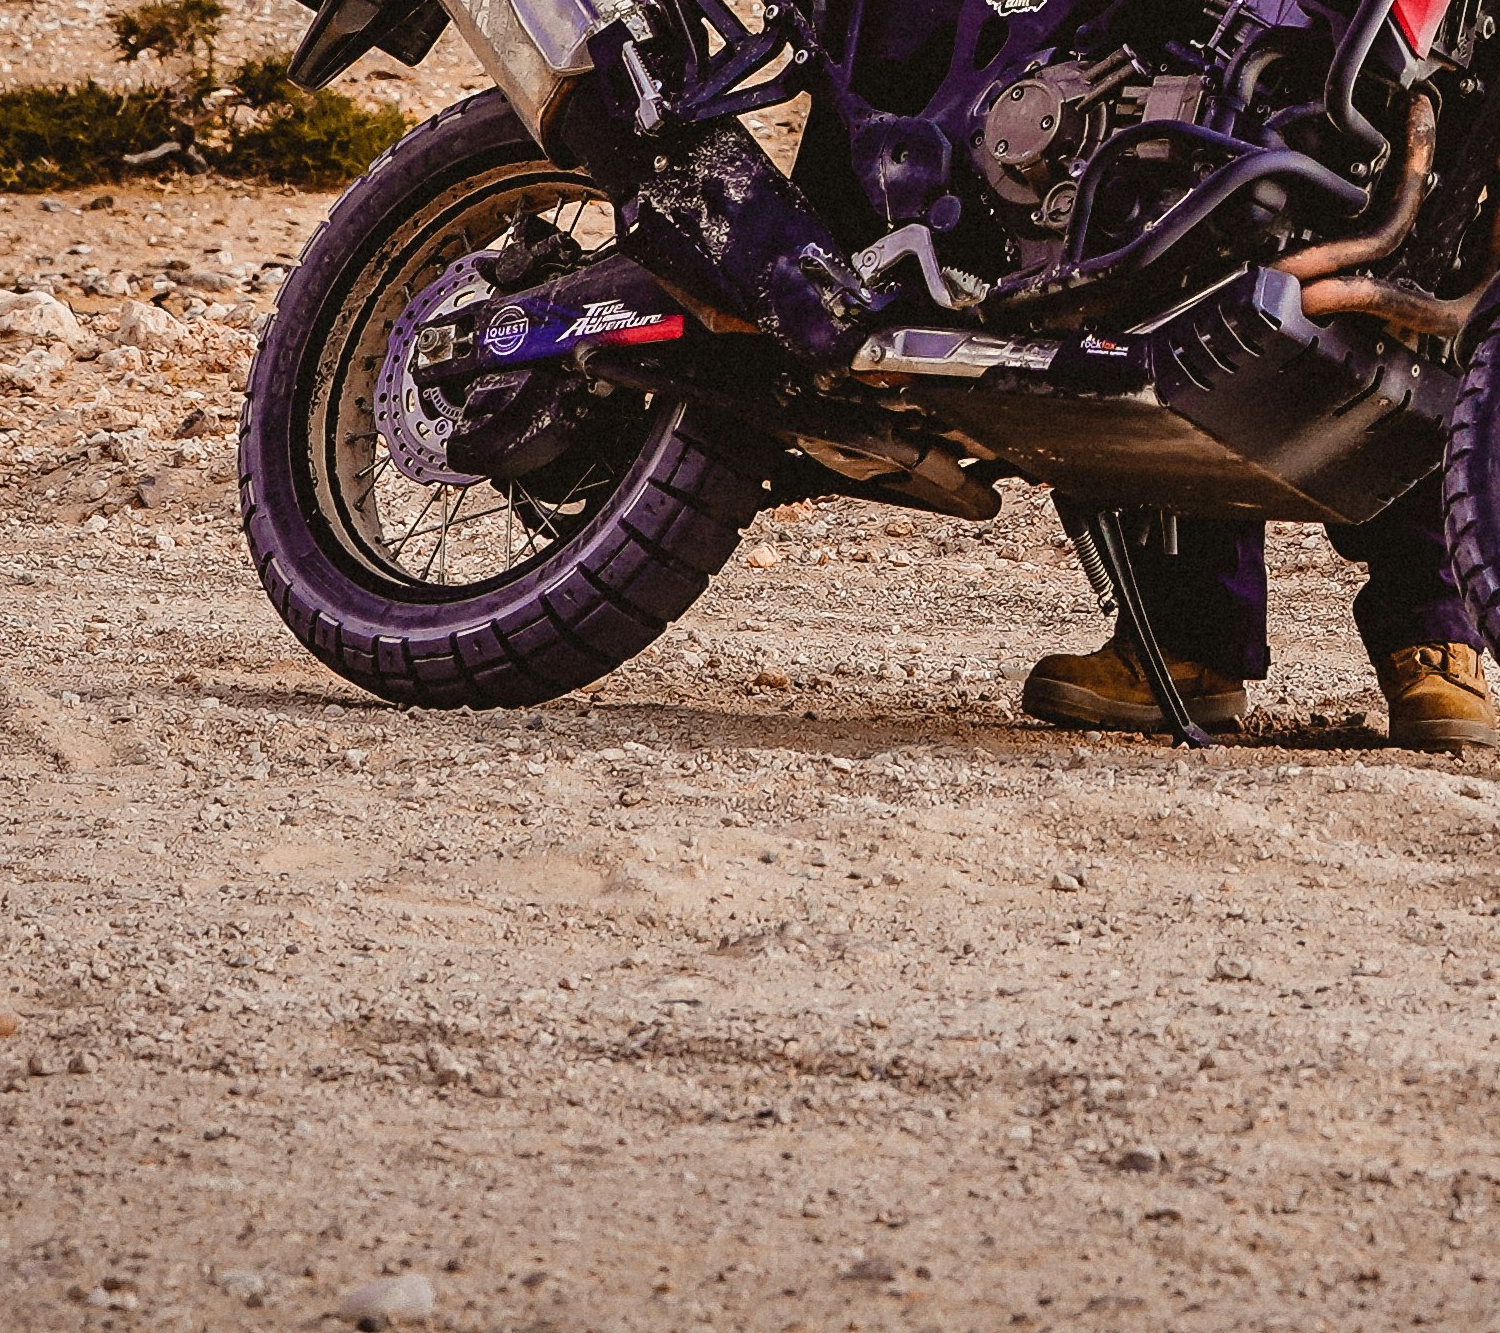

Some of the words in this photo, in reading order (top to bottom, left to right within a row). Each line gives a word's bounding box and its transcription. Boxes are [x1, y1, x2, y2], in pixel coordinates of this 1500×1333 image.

[582, 299, 632, 317] True
[490, 322, 526, 338] QUEST
[555, 310, 666, 343] Adventure
